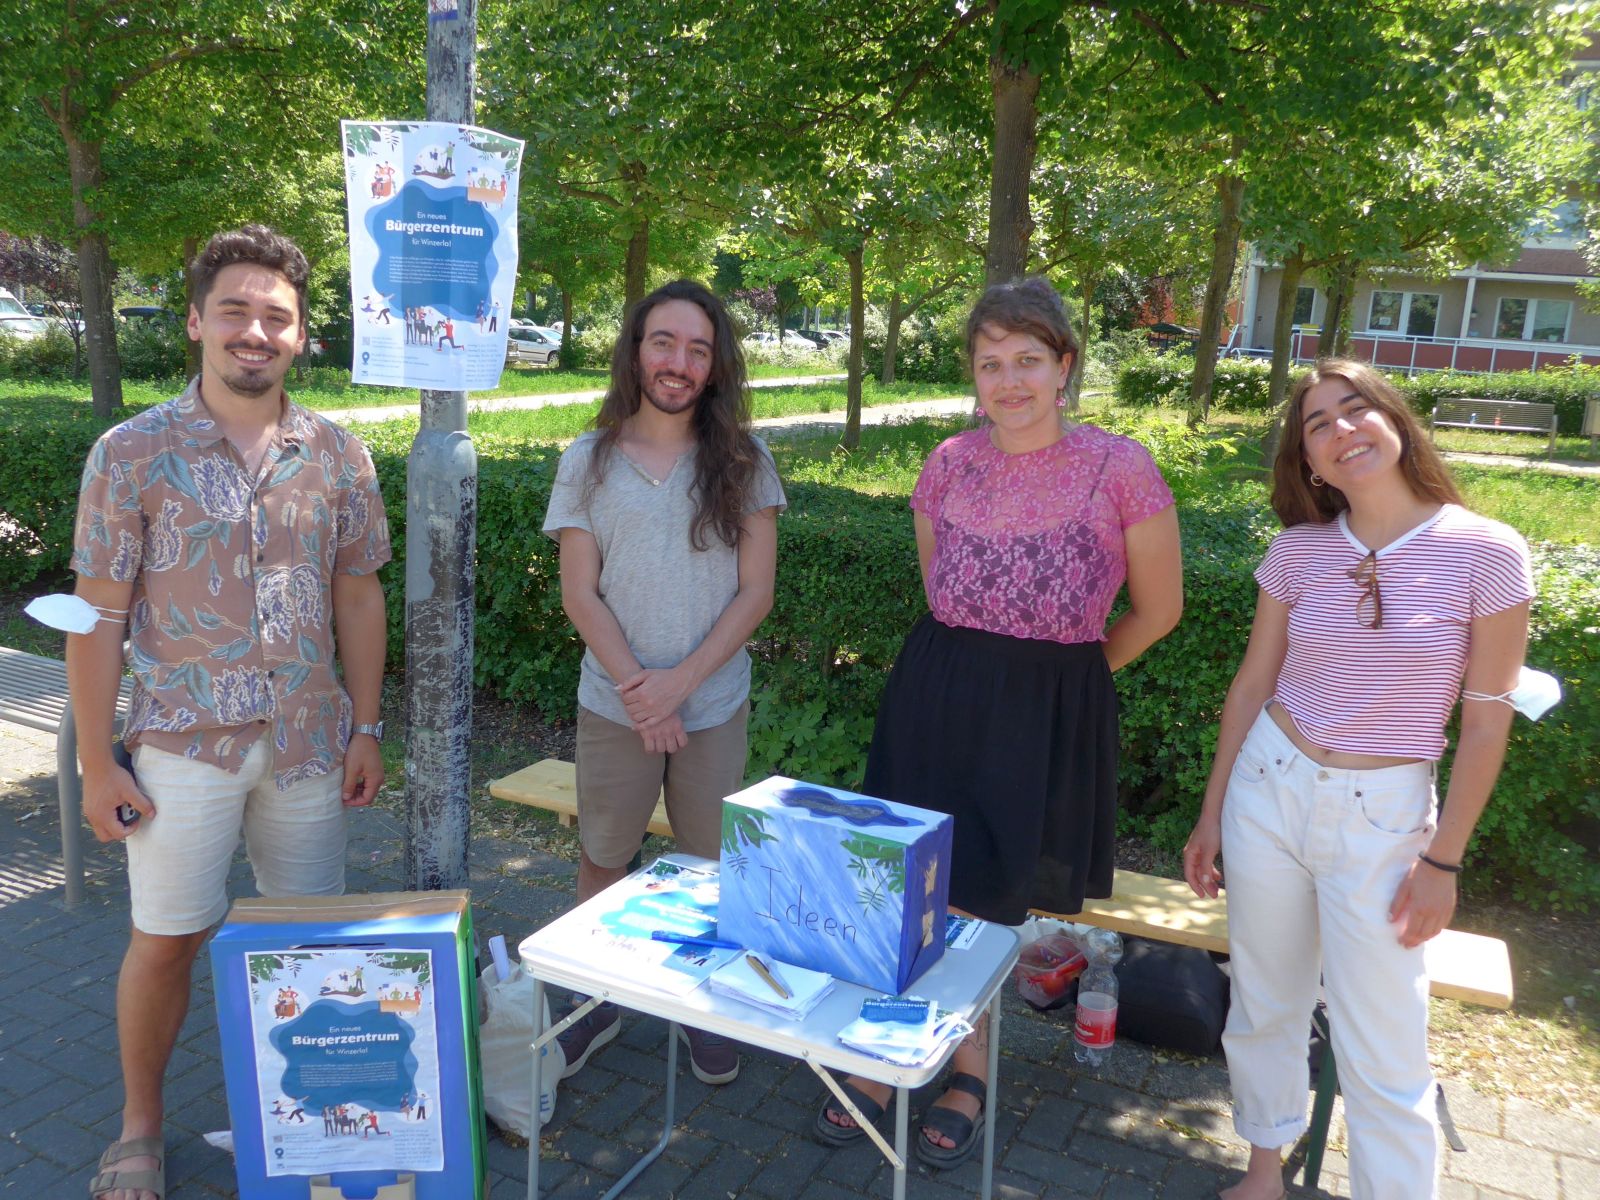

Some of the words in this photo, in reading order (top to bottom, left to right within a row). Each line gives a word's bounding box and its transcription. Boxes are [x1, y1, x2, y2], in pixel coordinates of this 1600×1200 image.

[417, 211, 426, 219] Ein
[385, 219, 484, 237] Bürgerzentrum
[412, 237, 420, 245] für
[754, 865, 857, 944] Ideen
[292, 1032, 400, 1047] Bürgerzentrum
